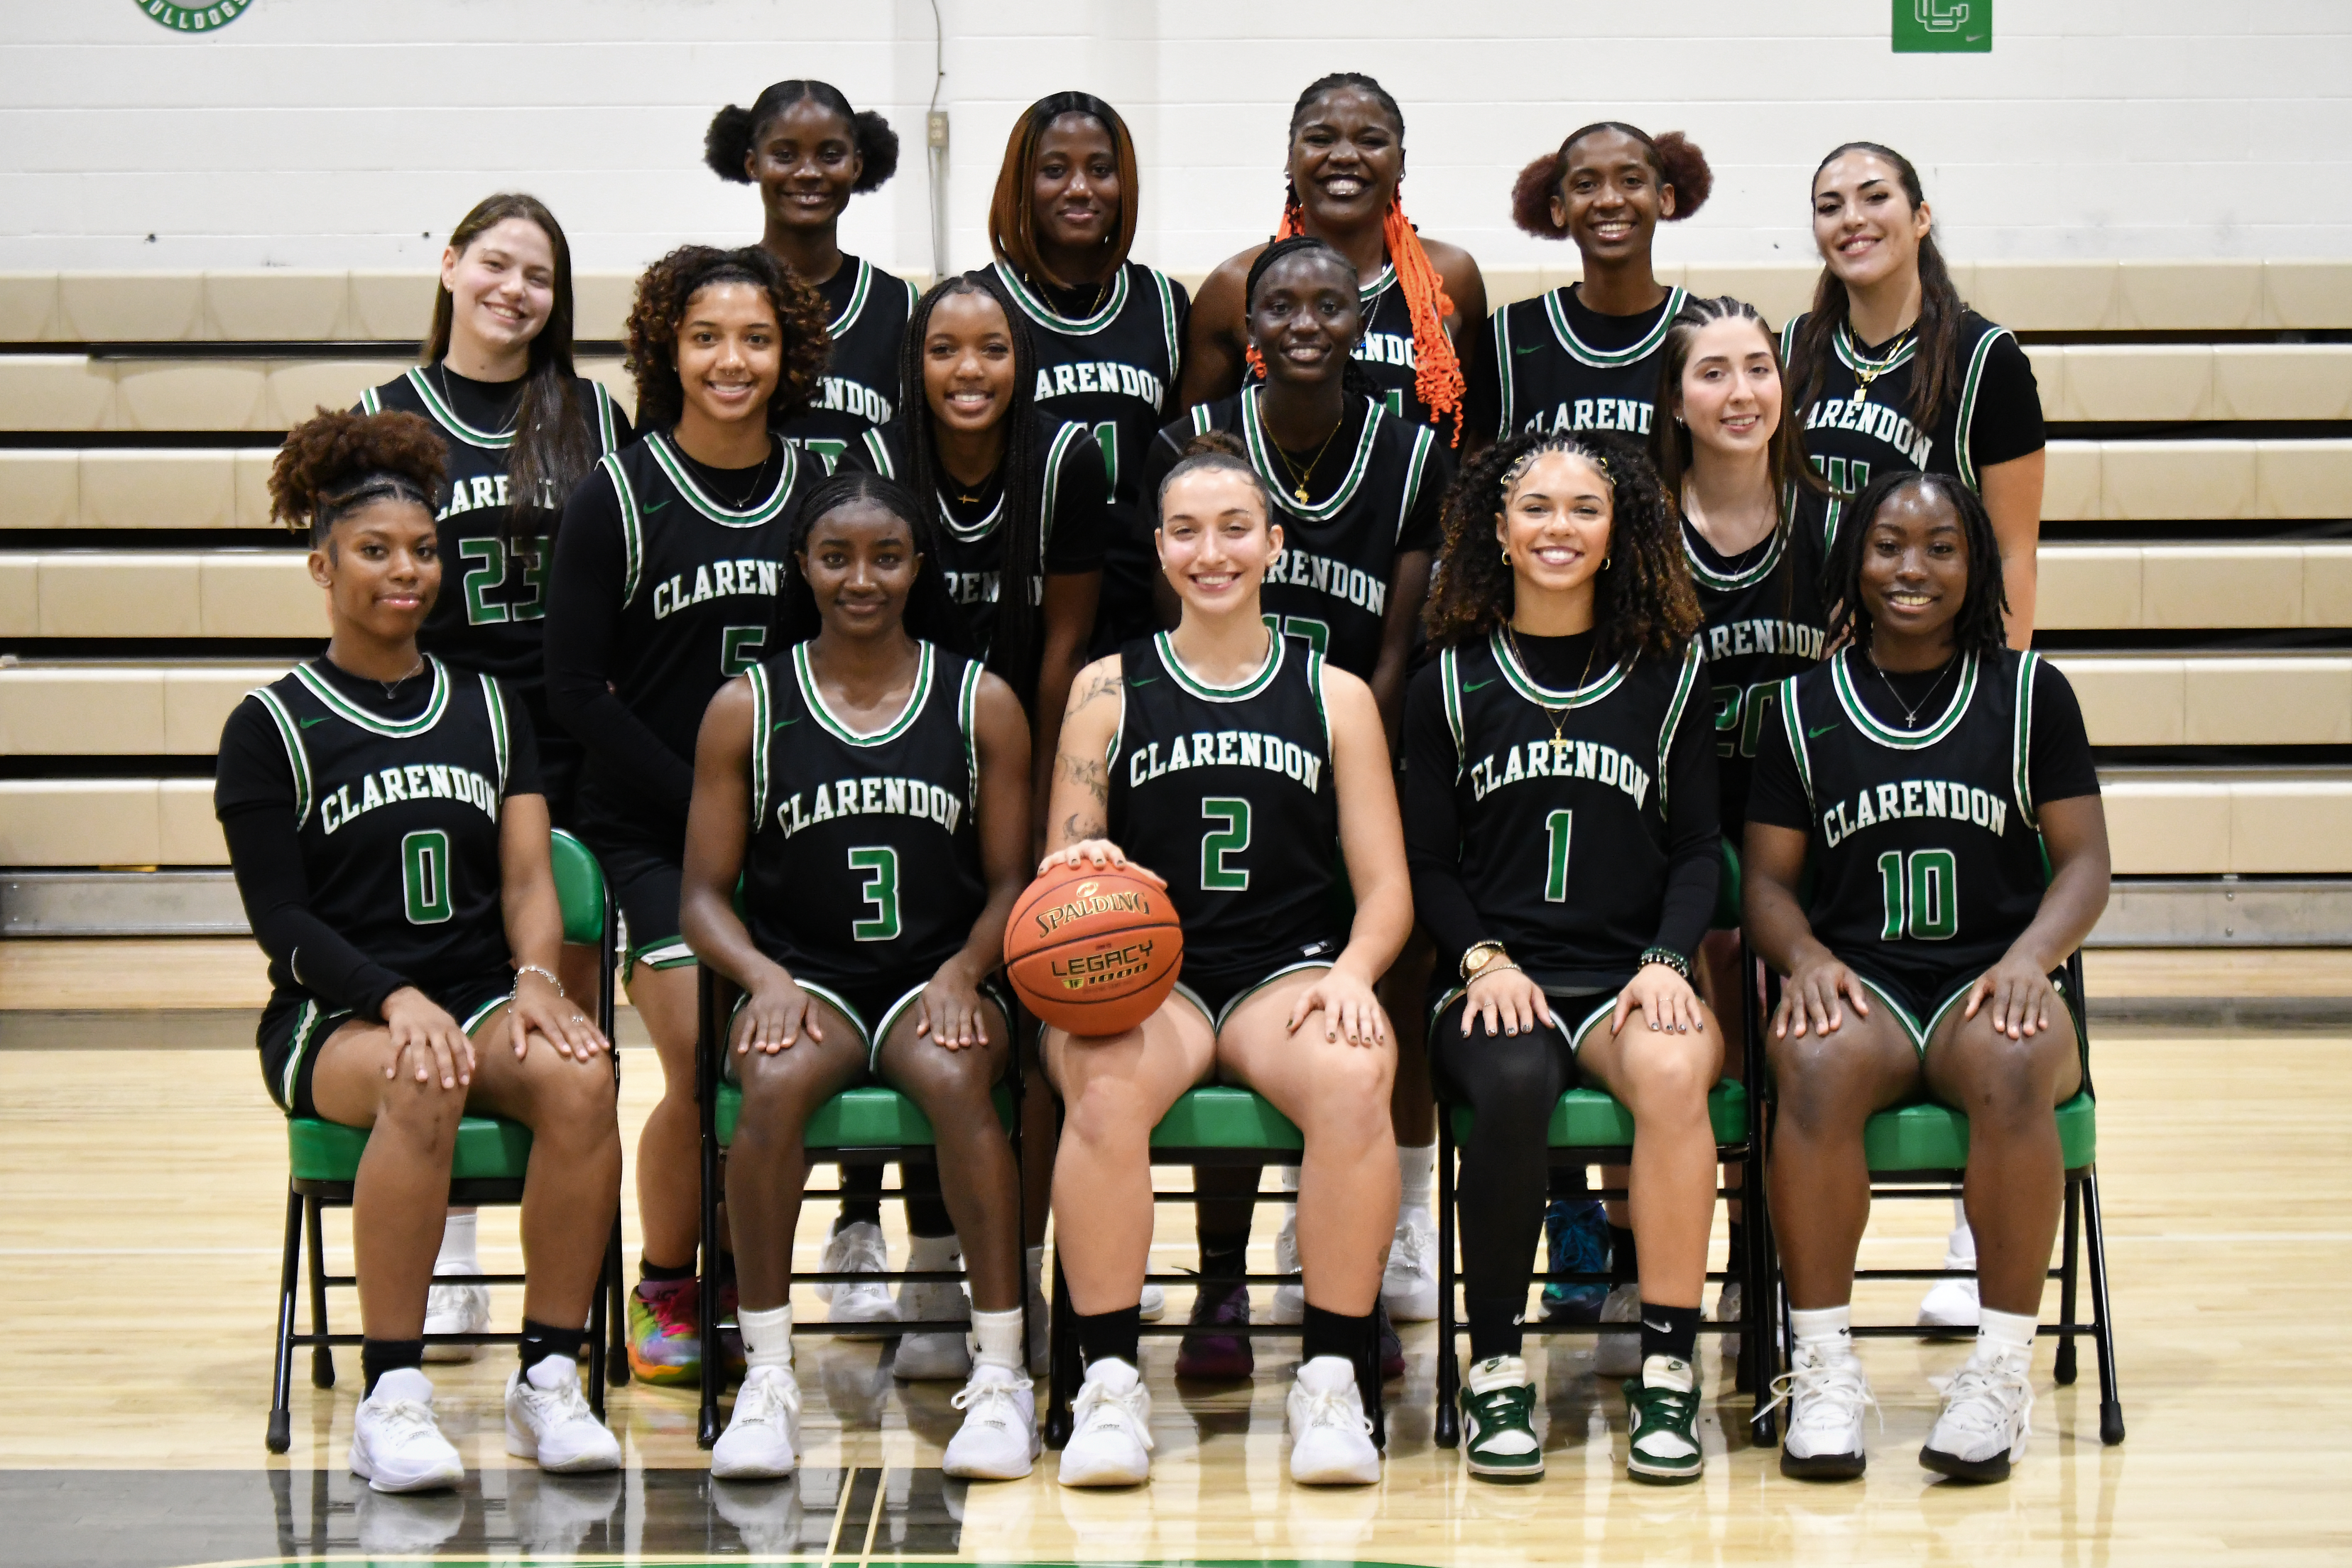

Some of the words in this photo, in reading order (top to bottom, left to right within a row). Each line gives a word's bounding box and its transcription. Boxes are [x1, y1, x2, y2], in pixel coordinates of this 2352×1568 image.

[459, 535, 549, 626] 23
[653, 559, 785, 620] CLAREN
[1261, 549, 1386, 617] RENDON
[1130, 731, 1321, 794] CLARENDON
[1471, 740, 1650, 811] CLARENDON
[321, 764, 496, 835] CLARENDON
[777, 777, 961, 840] CLARENDON
[1824, 780, 2007, 848] CLARENDON
[401, 829, 452, 925] 0
[1201, 797, 1252, 891] 2
[1544, 808, 1573, 903] 1
[848, 846, 901, 942] 3
[1035, 892, 1150, 939] SPALDING
[1877, 848, 1958, 942] 10
[1051, 939, 1153, 977] LEGACY
